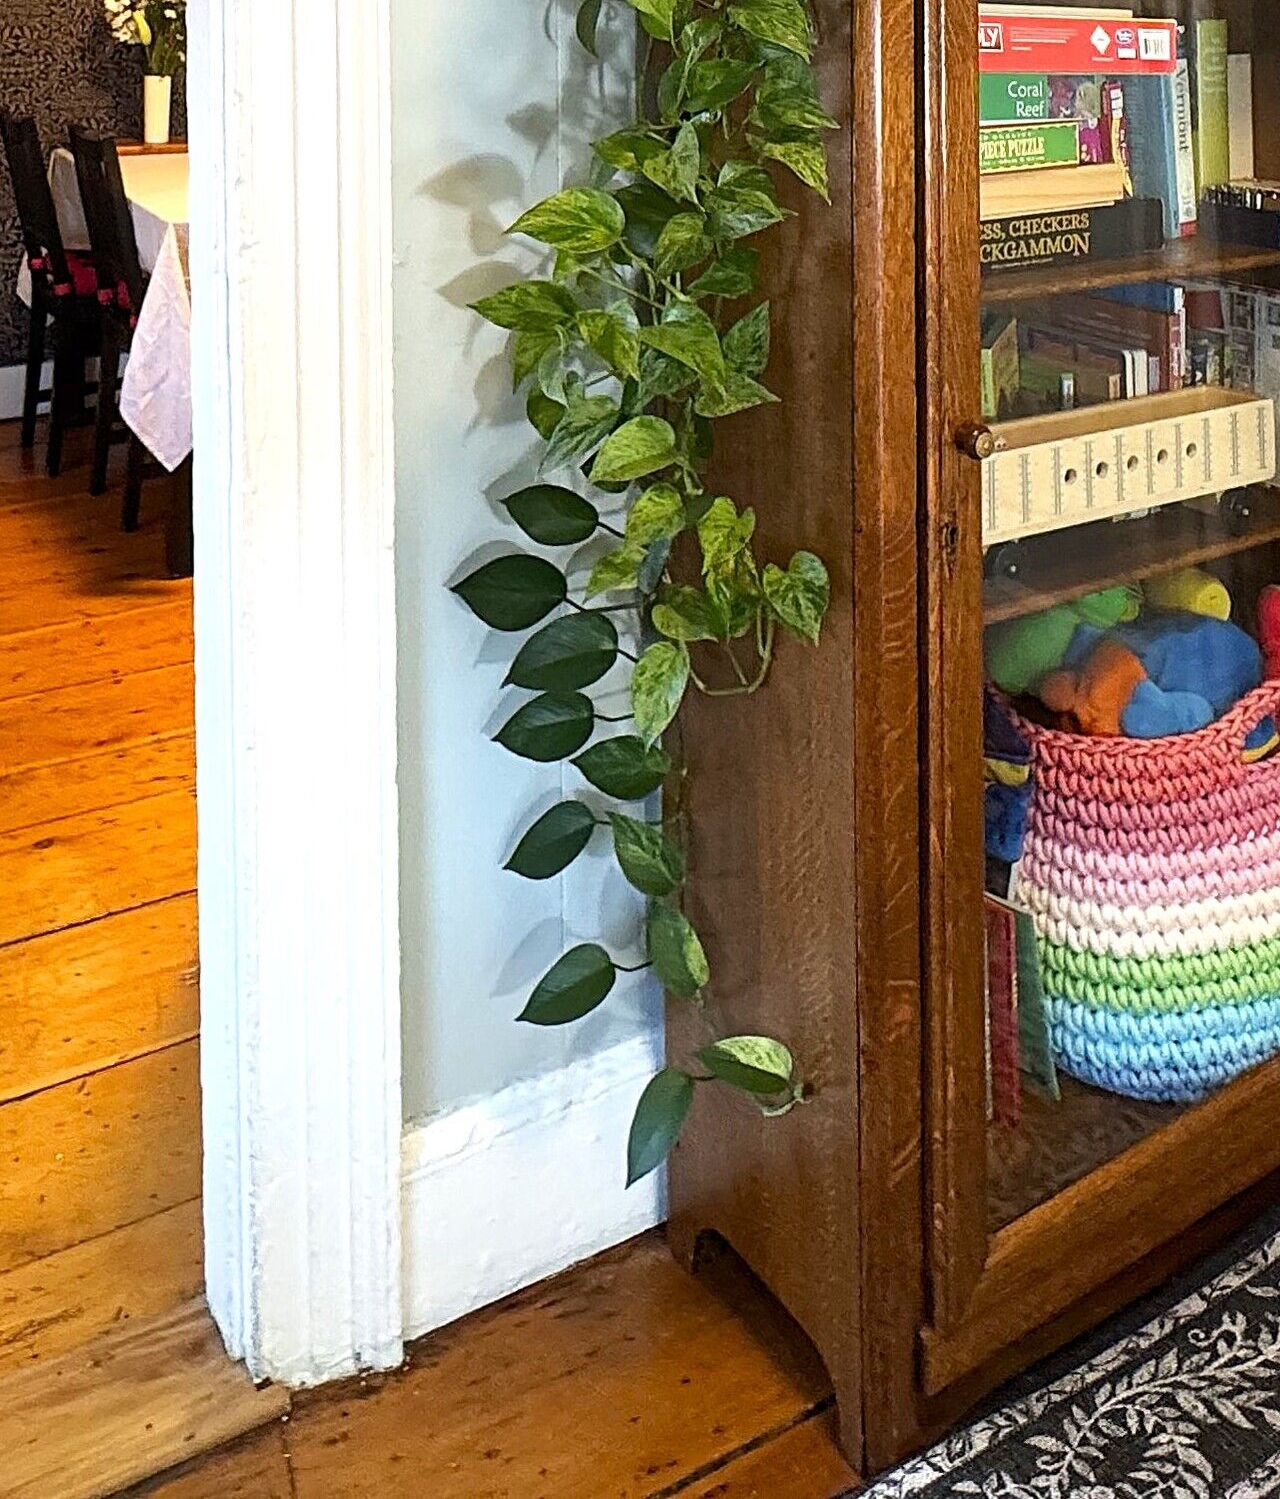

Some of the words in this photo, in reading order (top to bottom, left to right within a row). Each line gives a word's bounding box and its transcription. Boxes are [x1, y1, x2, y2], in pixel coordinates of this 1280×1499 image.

[979, 27, 999, 47] LY
[1007, 80, 1043, 98] Coral
[1016, 100, 1045, 117] Reef
[1175, 67, 1190, 152] Vermont
[1008, 136, 1045, 157] PUZZLE
[1009, 212, 1090, 237] CHECKERS
[980, 232, 1091, 263] CKGAMMON
